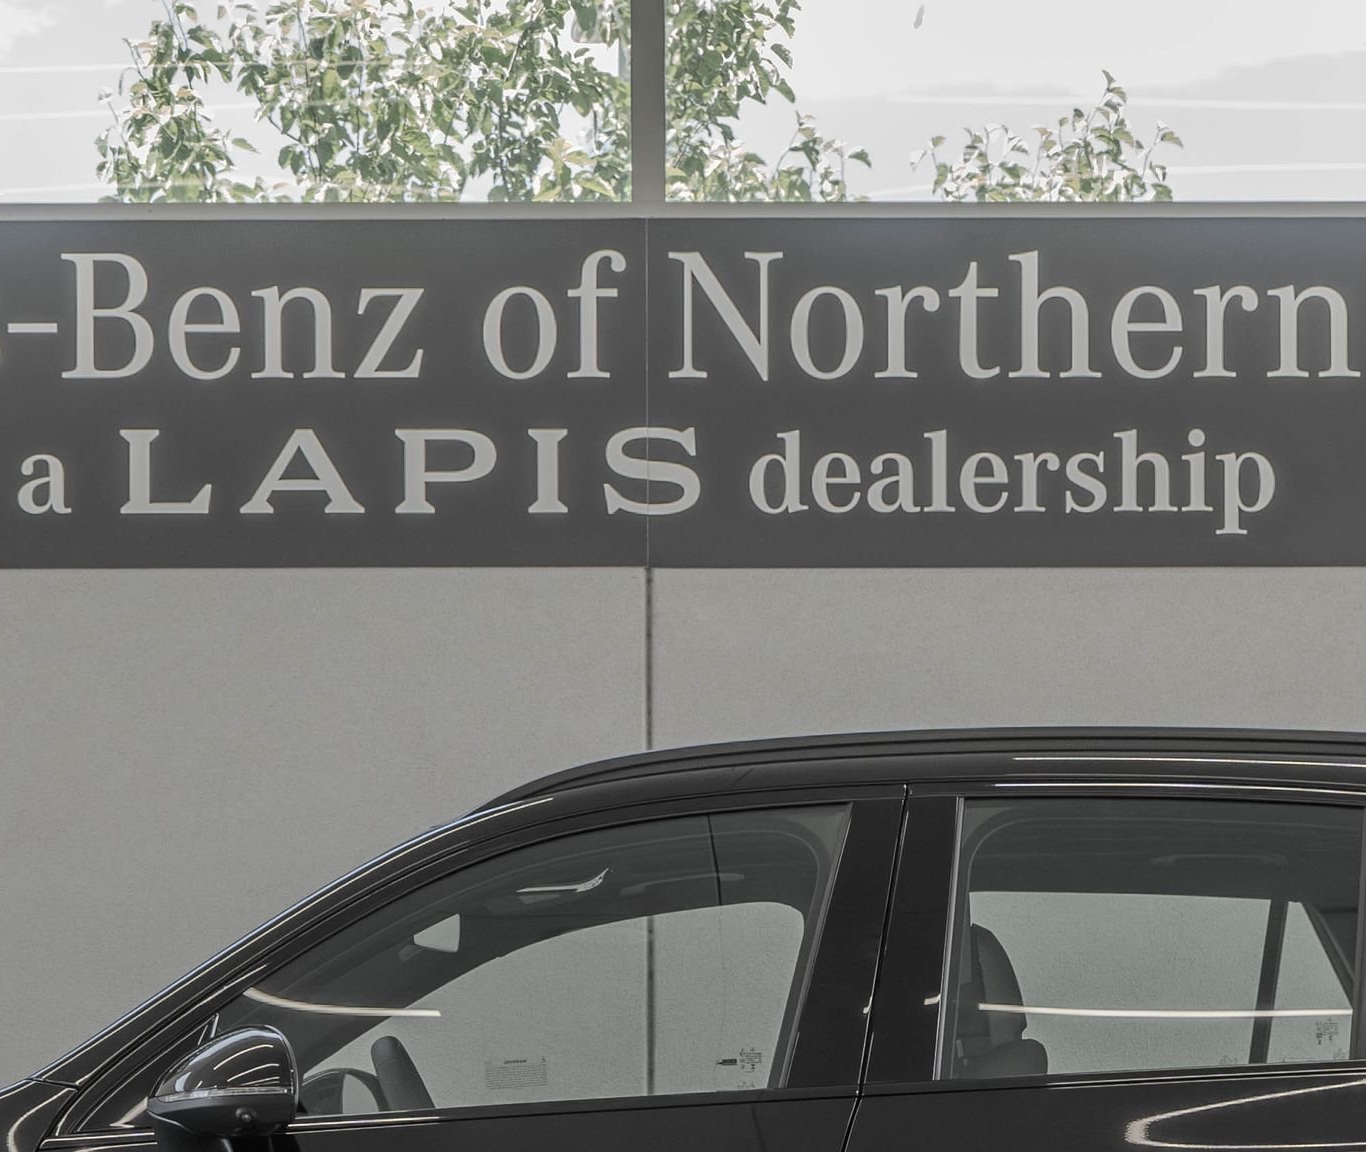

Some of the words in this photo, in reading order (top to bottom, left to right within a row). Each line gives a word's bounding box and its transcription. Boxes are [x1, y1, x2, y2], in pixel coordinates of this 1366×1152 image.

[482, 249, 627, 381] of
[666, 249, 1362, 382] Northern
[17, 454, 72, 515] a
[119, 426, 701, 516] LAPIS
[749, 428, 1276, 535] dealership
